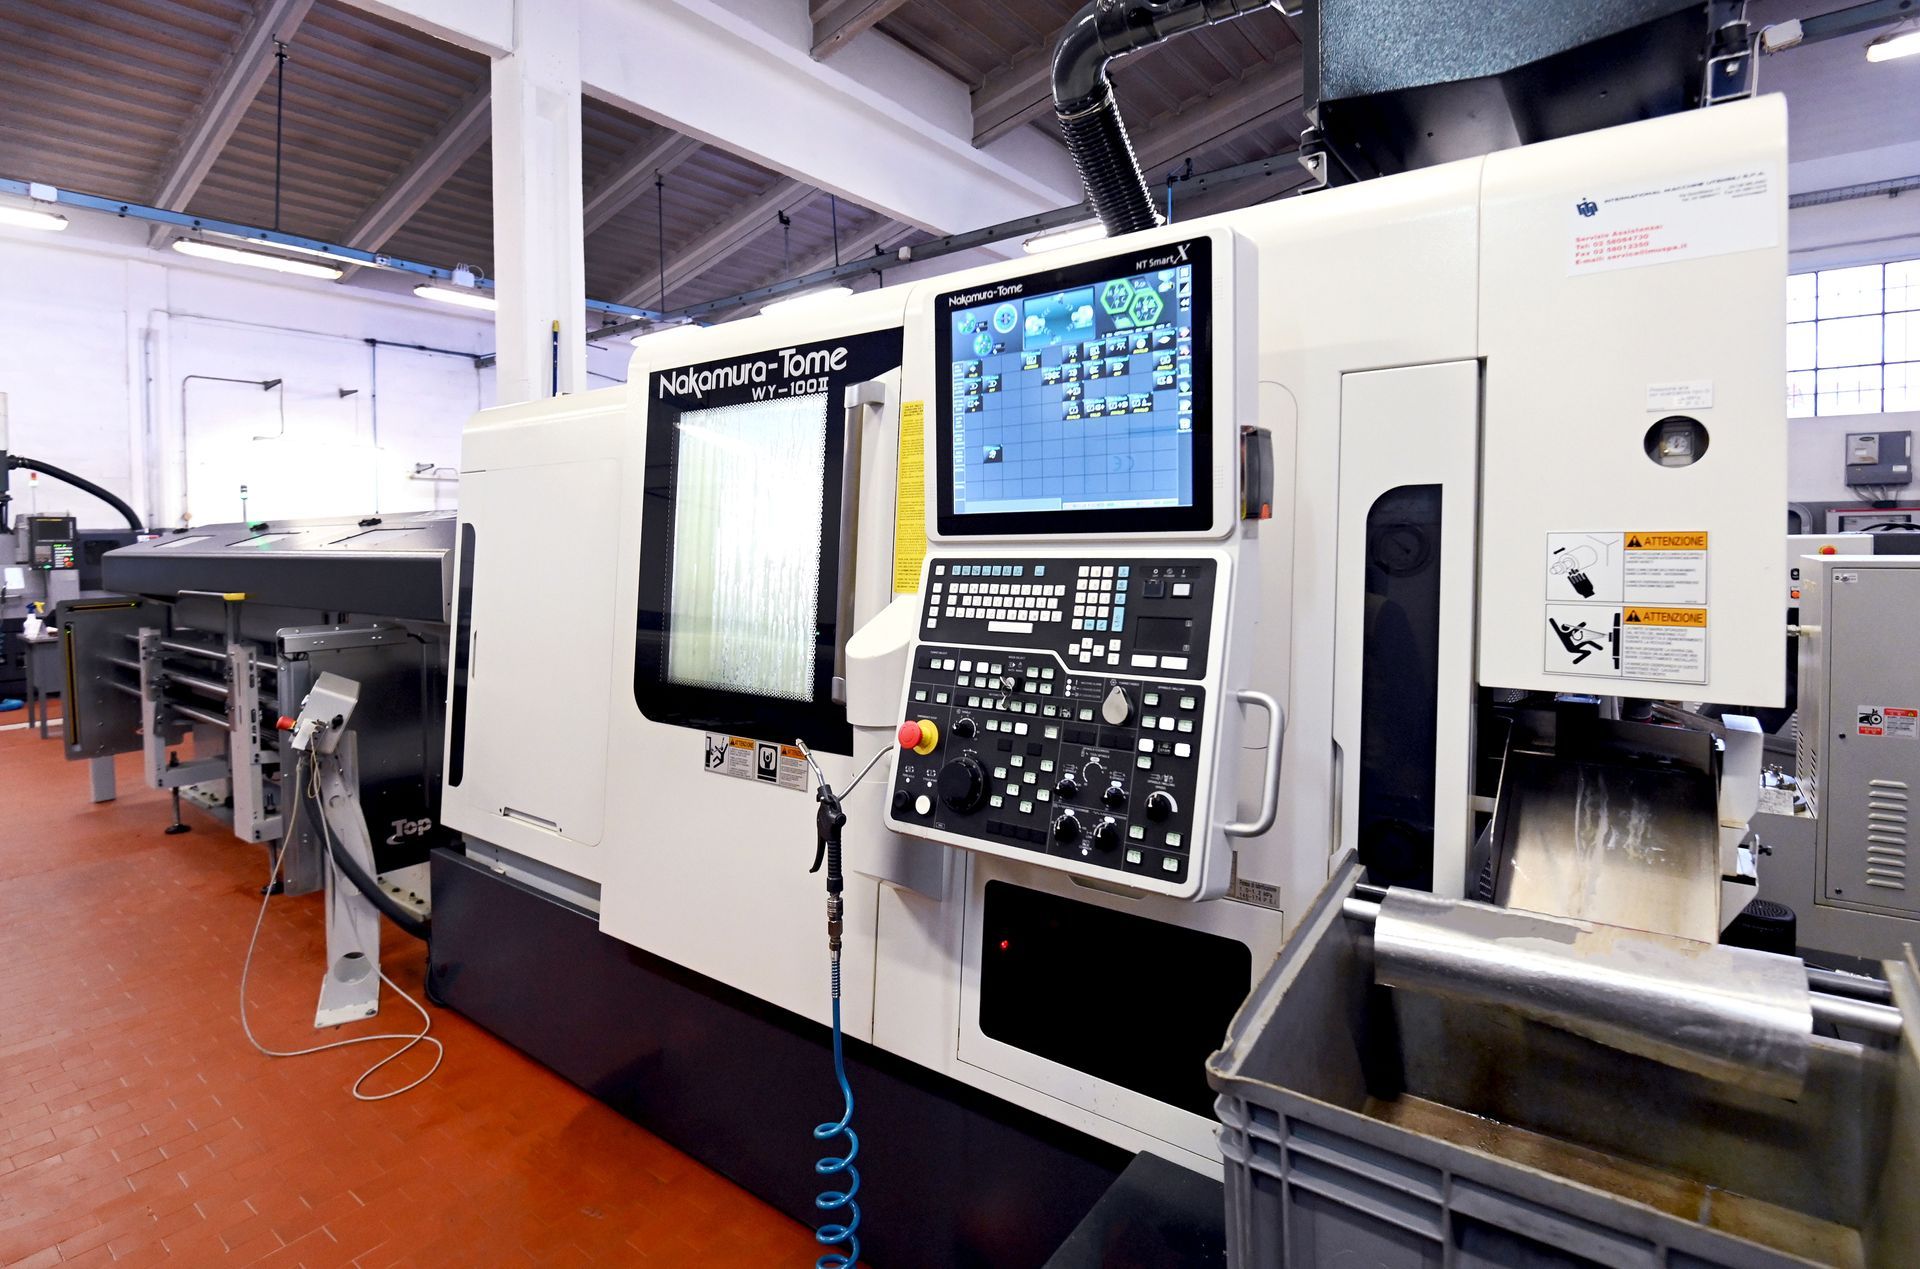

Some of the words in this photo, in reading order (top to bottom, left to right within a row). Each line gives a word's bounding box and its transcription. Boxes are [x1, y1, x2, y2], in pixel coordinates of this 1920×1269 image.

[1135, 260, 1148, 270] NT
[948, 283, 1023, 307] Nakamura-Tome
[659, 346, 849, 399] Nakamura-Tome
[1645, 535, 1704, 547] ATTENZIONE
[1643, 612, 1703, 624] ATTENZIONE
[391, 817, 432, 837] Top
